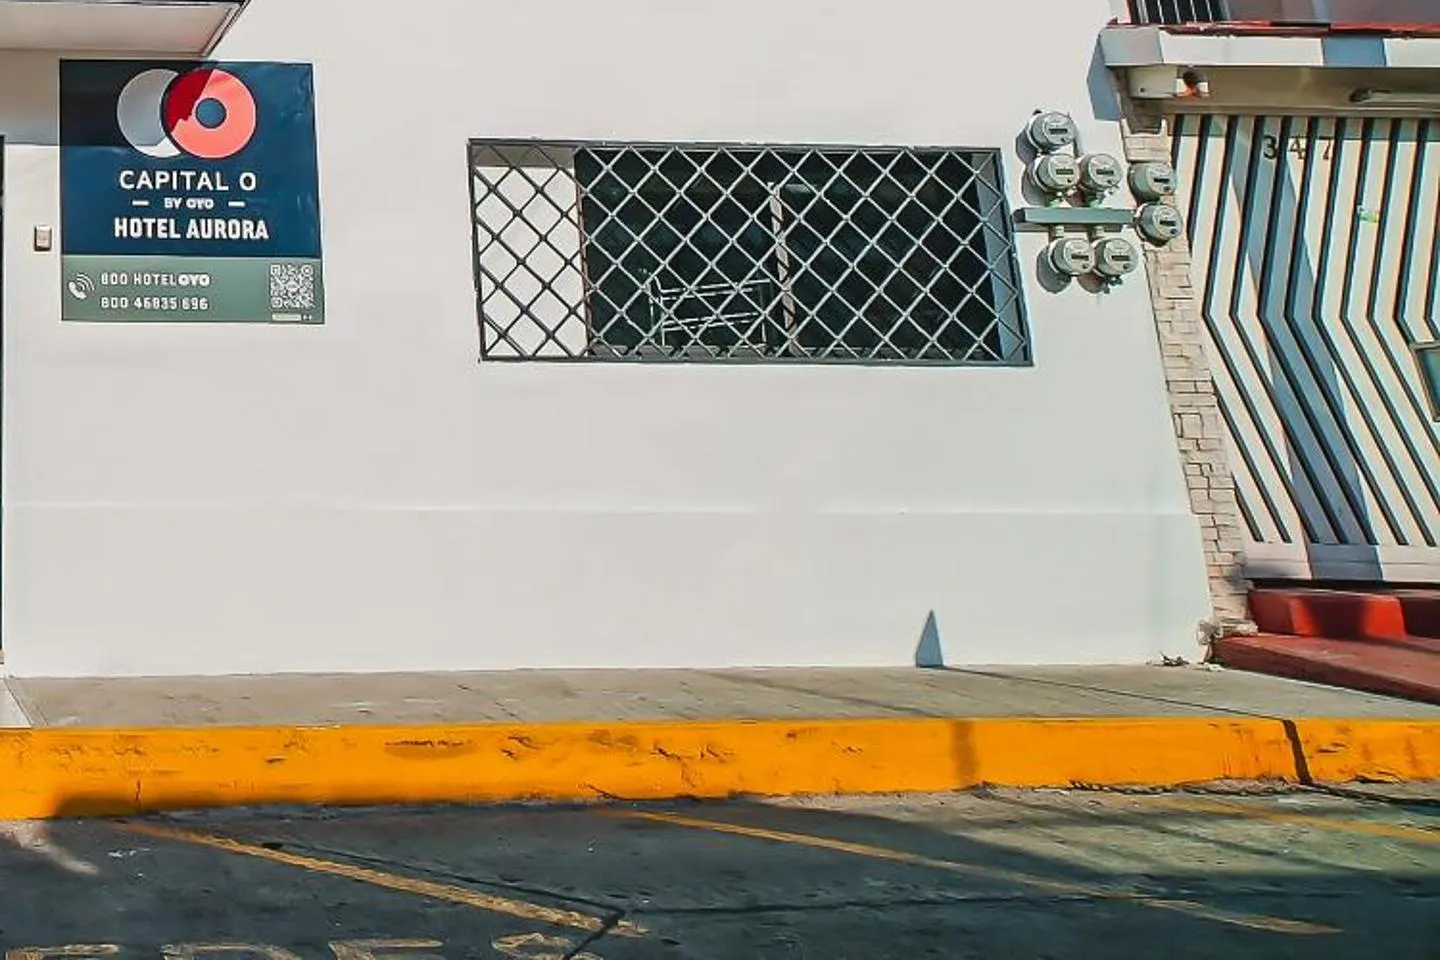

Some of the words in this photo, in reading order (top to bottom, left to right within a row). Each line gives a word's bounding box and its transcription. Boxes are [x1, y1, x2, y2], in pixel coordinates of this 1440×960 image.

[119, 170, 229, 191] CAPITAL
[239, 171, 257, 191] O
[164, 197, 183, 209] BY
[186, 198, 215, 210] OYO
[114, 217, 181, 239] HOTEL
[186, 218, 269, 240] AURORA
[101, 297, 129, 309] 800
